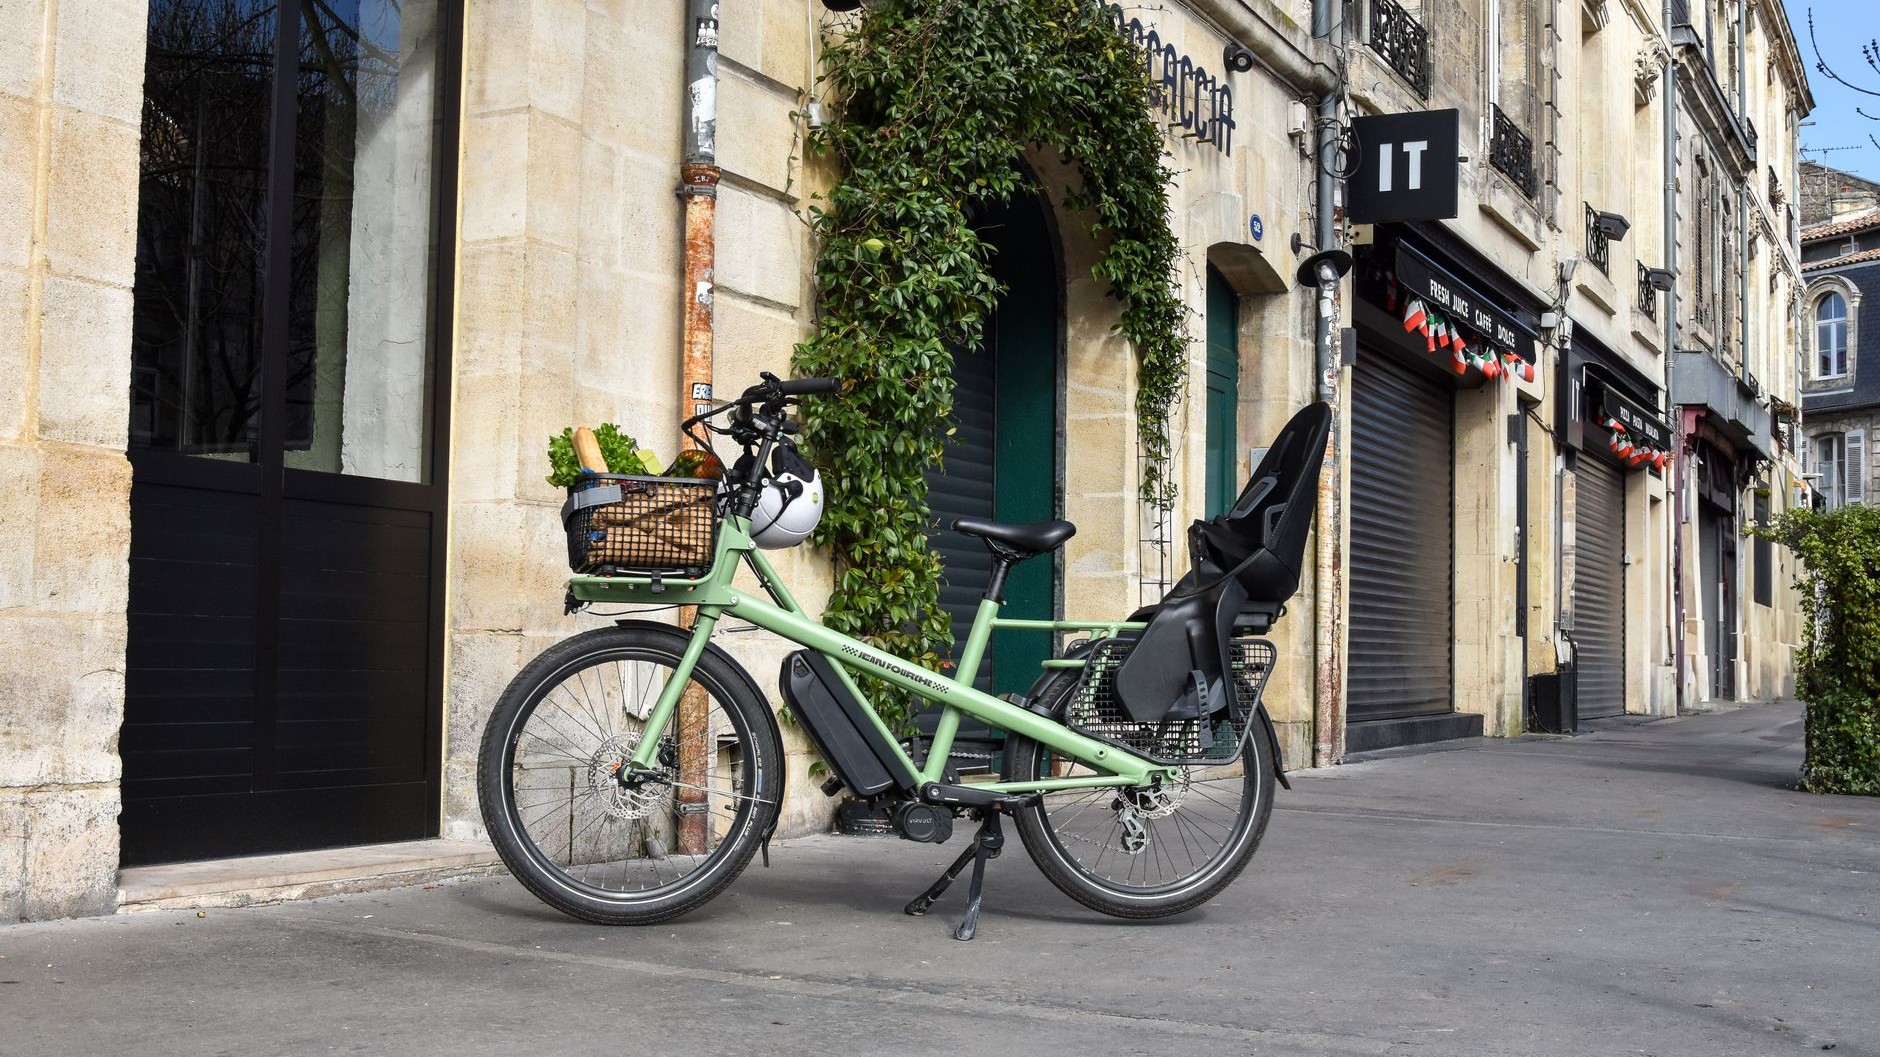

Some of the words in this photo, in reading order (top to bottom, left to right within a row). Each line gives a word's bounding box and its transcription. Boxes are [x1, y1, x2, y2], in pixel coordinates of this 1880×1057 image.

[1379, 140, 1428, 192] IT
[1430, 279, 1450, 306] FRESH
[1452, 294, 1469, 318] JUICE
[1497, 324, 1515, 348] DOLCE
[1619, 405, 1630, 423] PIZZA
[1632, 414, 1643, 431] PASTA
